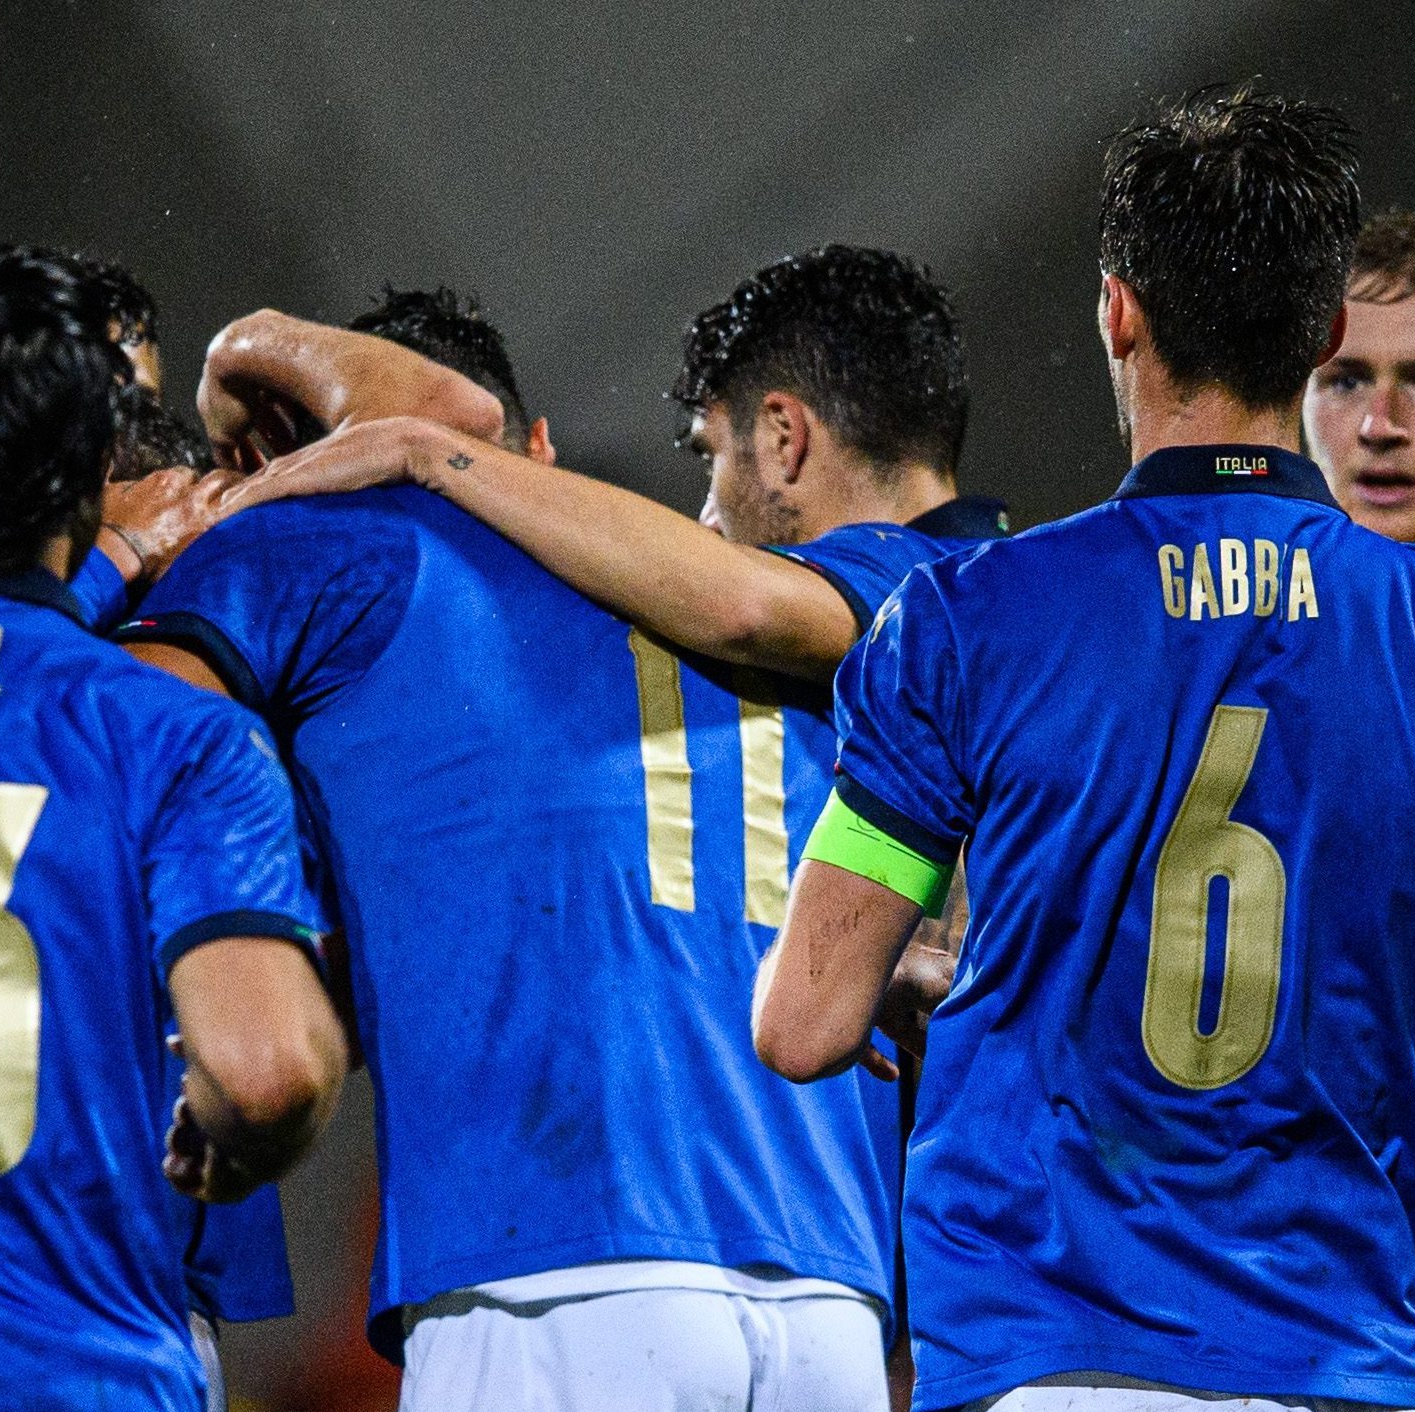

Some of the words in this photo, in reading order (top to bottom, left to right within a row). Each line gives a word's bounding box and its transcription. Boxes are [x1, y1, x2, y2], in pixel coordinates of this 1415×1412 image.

[1215, 456, 1268, 471] ITALIA
[1158, 538, 1320, 622] GABBA
[1141, 704, 1286, 1091] 6
